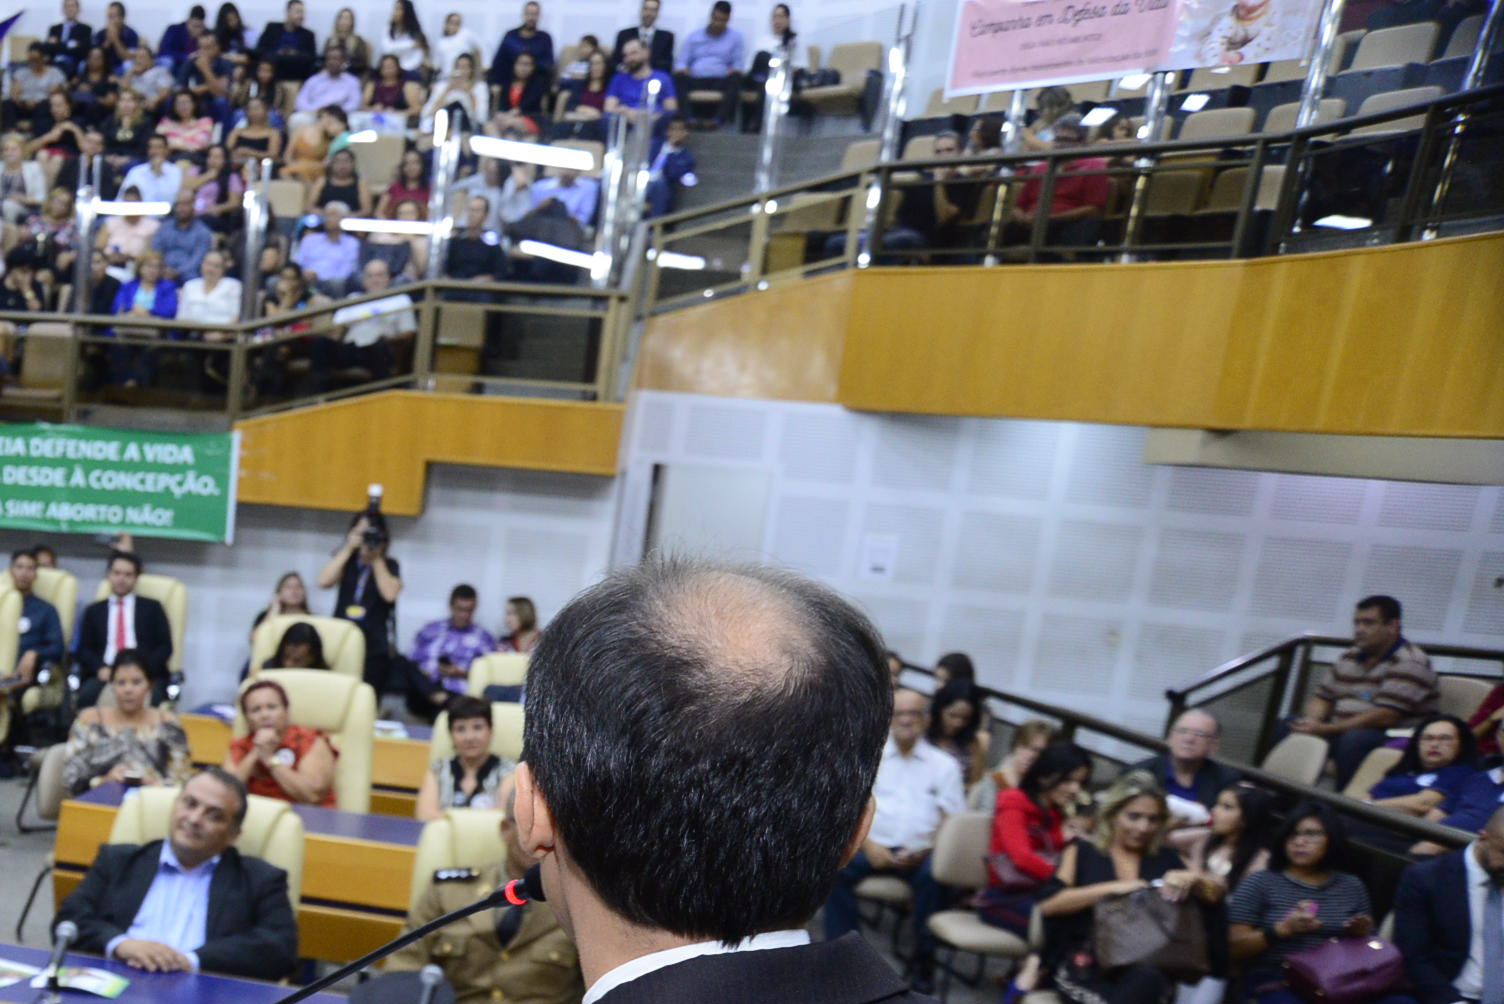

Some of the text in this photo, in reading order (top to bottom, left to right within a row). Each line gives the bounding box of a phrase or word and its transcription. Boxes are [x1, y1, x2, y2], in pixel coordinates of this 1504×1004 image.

[29, 438, 122, 462] DEFENDE
[123, 441, 141, 462] A
[142, 442, 195, 465] VIDA
[2, 464, 66, 487] DESDE
[88, 467, 221, 499] CONCEPÇÃO.
[4, 499, 45, 518] SIM!
[47, 501, 124, 525] ABORTO
[125, 502, 174, 527] NÃO!
